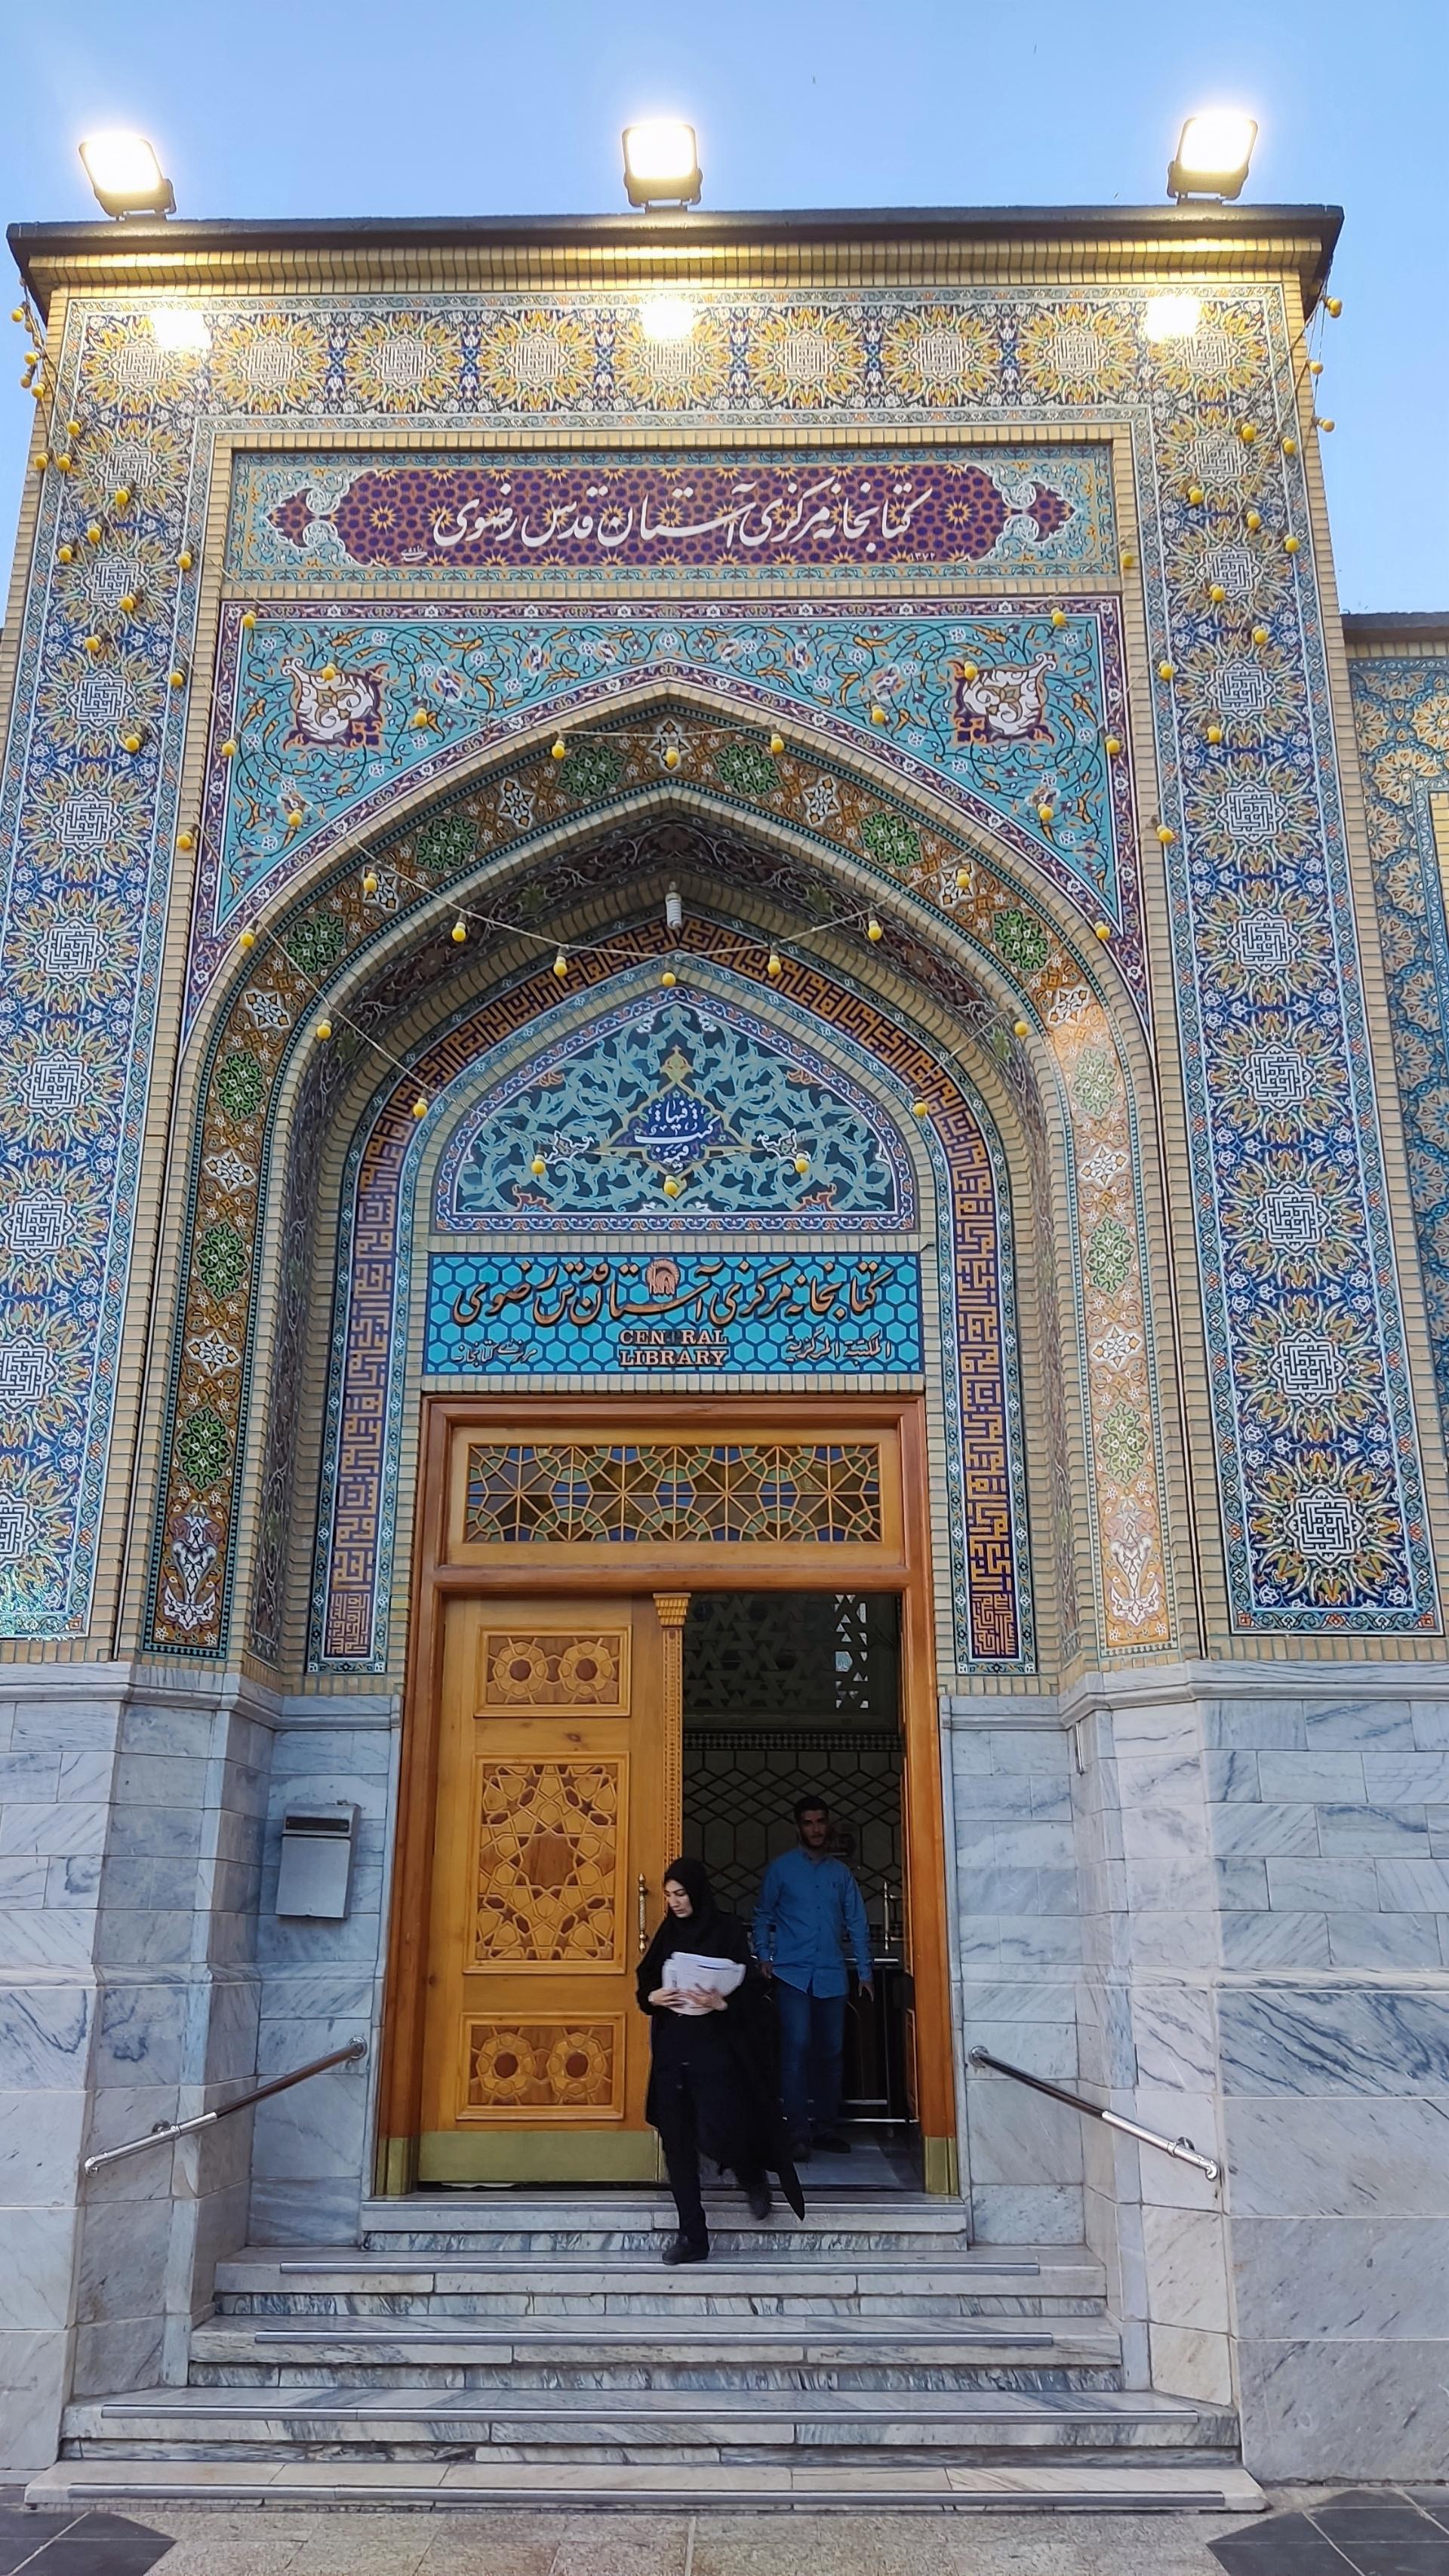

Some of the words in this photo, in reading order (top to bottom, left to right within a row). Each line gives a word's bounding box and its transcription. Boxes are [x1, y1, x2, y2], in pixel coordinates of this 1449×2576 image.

[433, 483, 518, 547] رضوی
[521, 485, 609, 547] قدس
[597, 481, 757, 548] آستان
[739, 475, 835, 547] مرکزی
[453, 1260, 558, 1325] رضوی
[534, 1261, 610, 1326] قدس
[569, 1261, 724, 1326] آستان
[709, 1260, 792, 1326] مرکزی
[620, 1329, 728, 1345] CENRAL
[620, 1350, 728, 1366] LIBRARY
